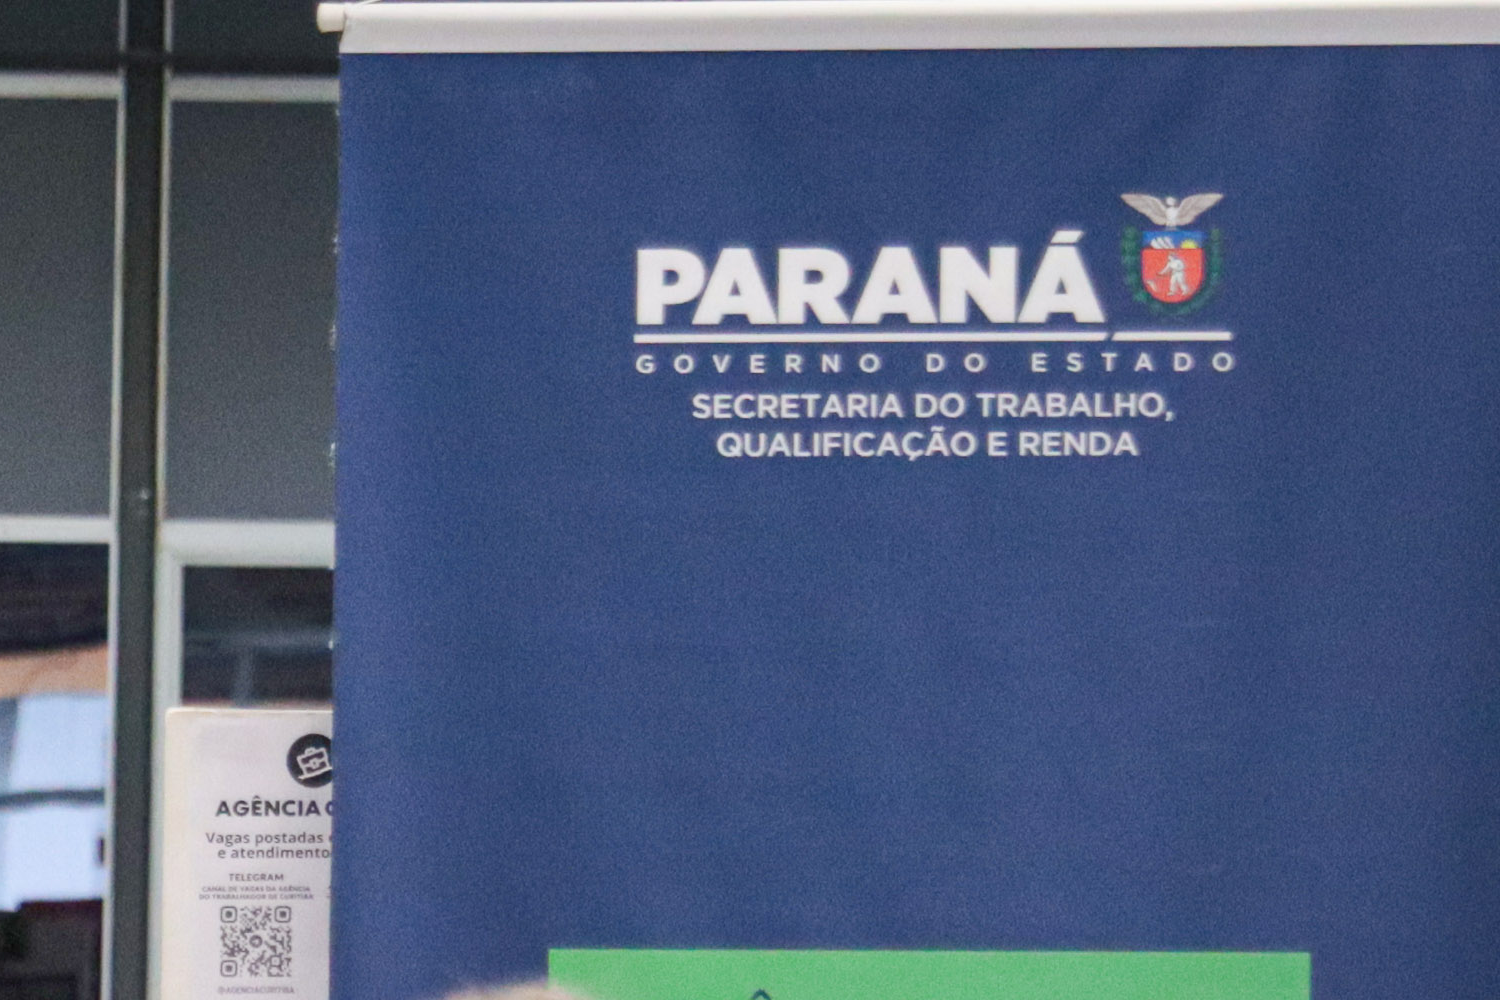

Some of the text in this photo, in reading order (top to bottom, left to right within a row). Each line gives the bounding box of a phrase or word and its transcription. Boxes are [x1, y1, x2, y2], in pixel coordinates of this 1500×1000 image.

[636, 229, 1106, 325] PARANÁ
[635, 351, 1235, 374] GOVERNO DO ESTADO
[692, 391, 1174, 421] SECRETARIA DO TRABALHO,
[716, 426, 1139, 461] QUALIFICAÇÃO E RENDA
[216, 795, 322, 817] AGÊNCIA
[205, 832, 251, 847] Vagas
[255, 831, 324, 846] postadas
[217, 848, 227, 859] e
[229, 873, 285, 882] TELEGRAM
